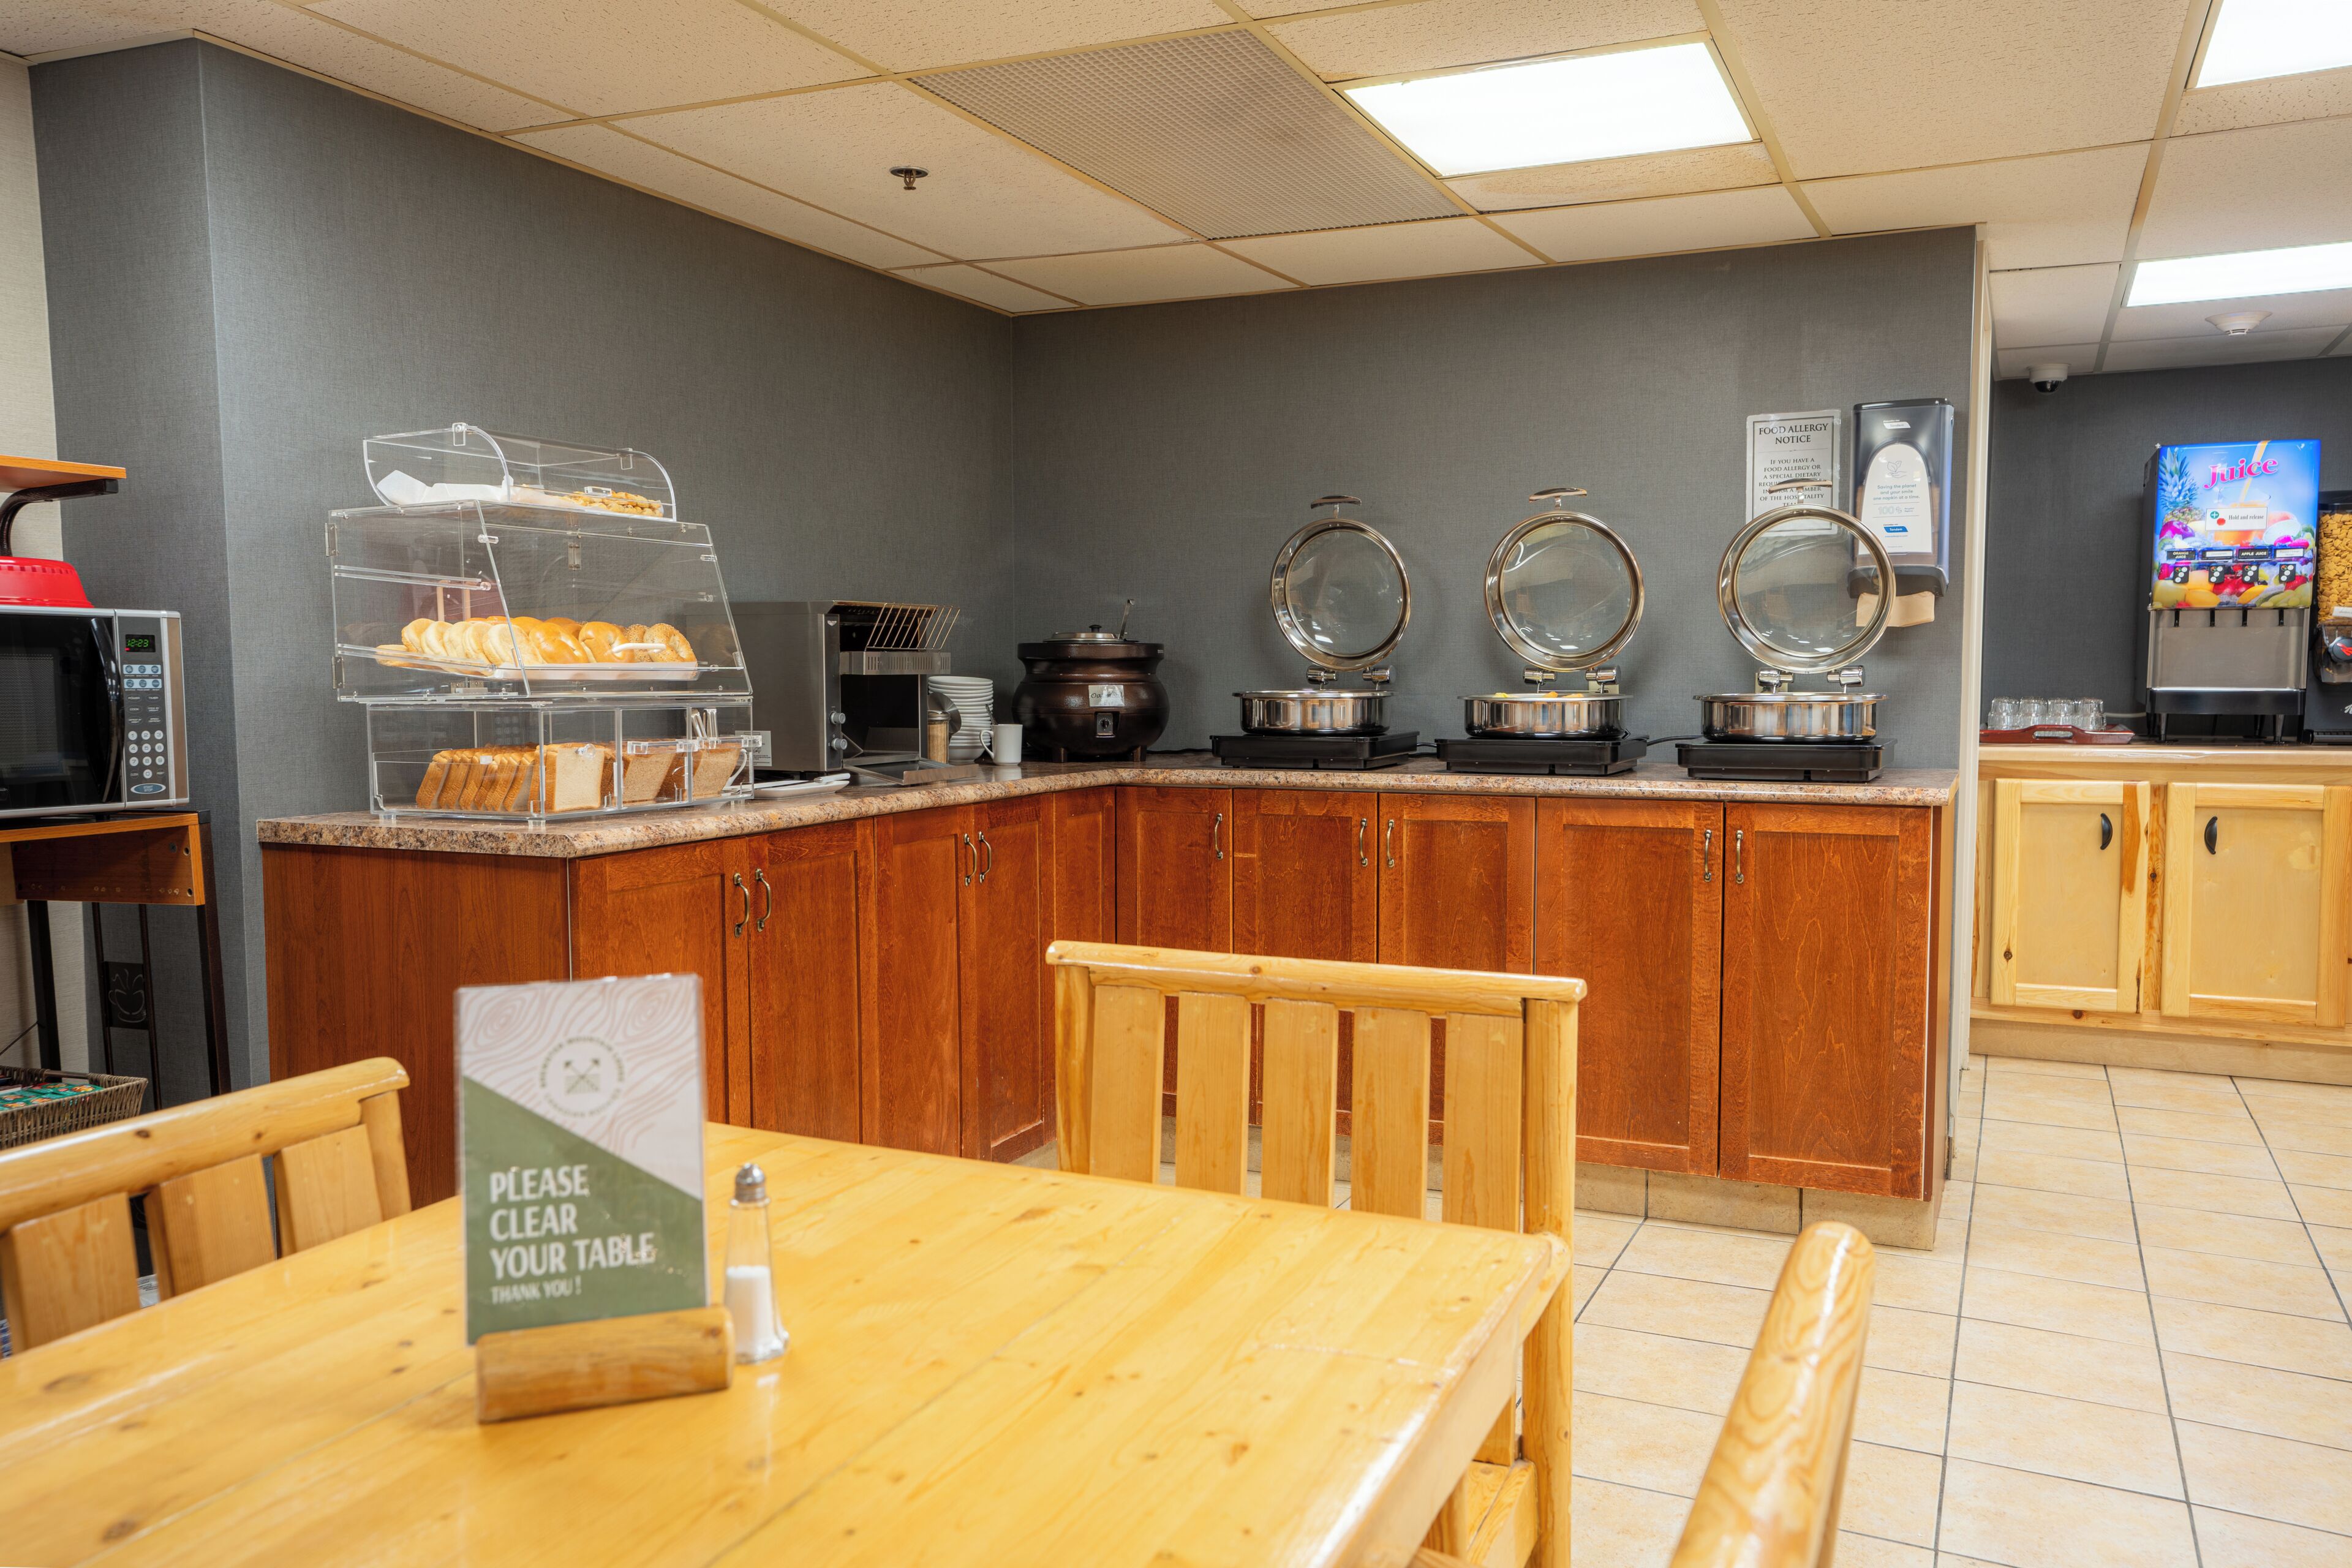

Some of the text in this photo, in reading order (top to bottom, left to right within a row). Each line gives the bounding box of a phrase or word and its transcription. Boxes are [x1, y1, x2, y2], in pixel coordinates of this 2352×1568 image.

[1759, 423, 1828, 435] FOOD ALLERGY
[1776, 435, 1811, 444] NOTICE
[2203, 458, 2278, 489] Juice
[127, 639, 149, 647] 12:23
[490, 1164, 589, 1204] PLEASE
[489, 1203, 578, 1242] CLEAR
[489, 1232, 657, 1280] YOUR TABLE
[491, 1283, 541, 1305] THANK
